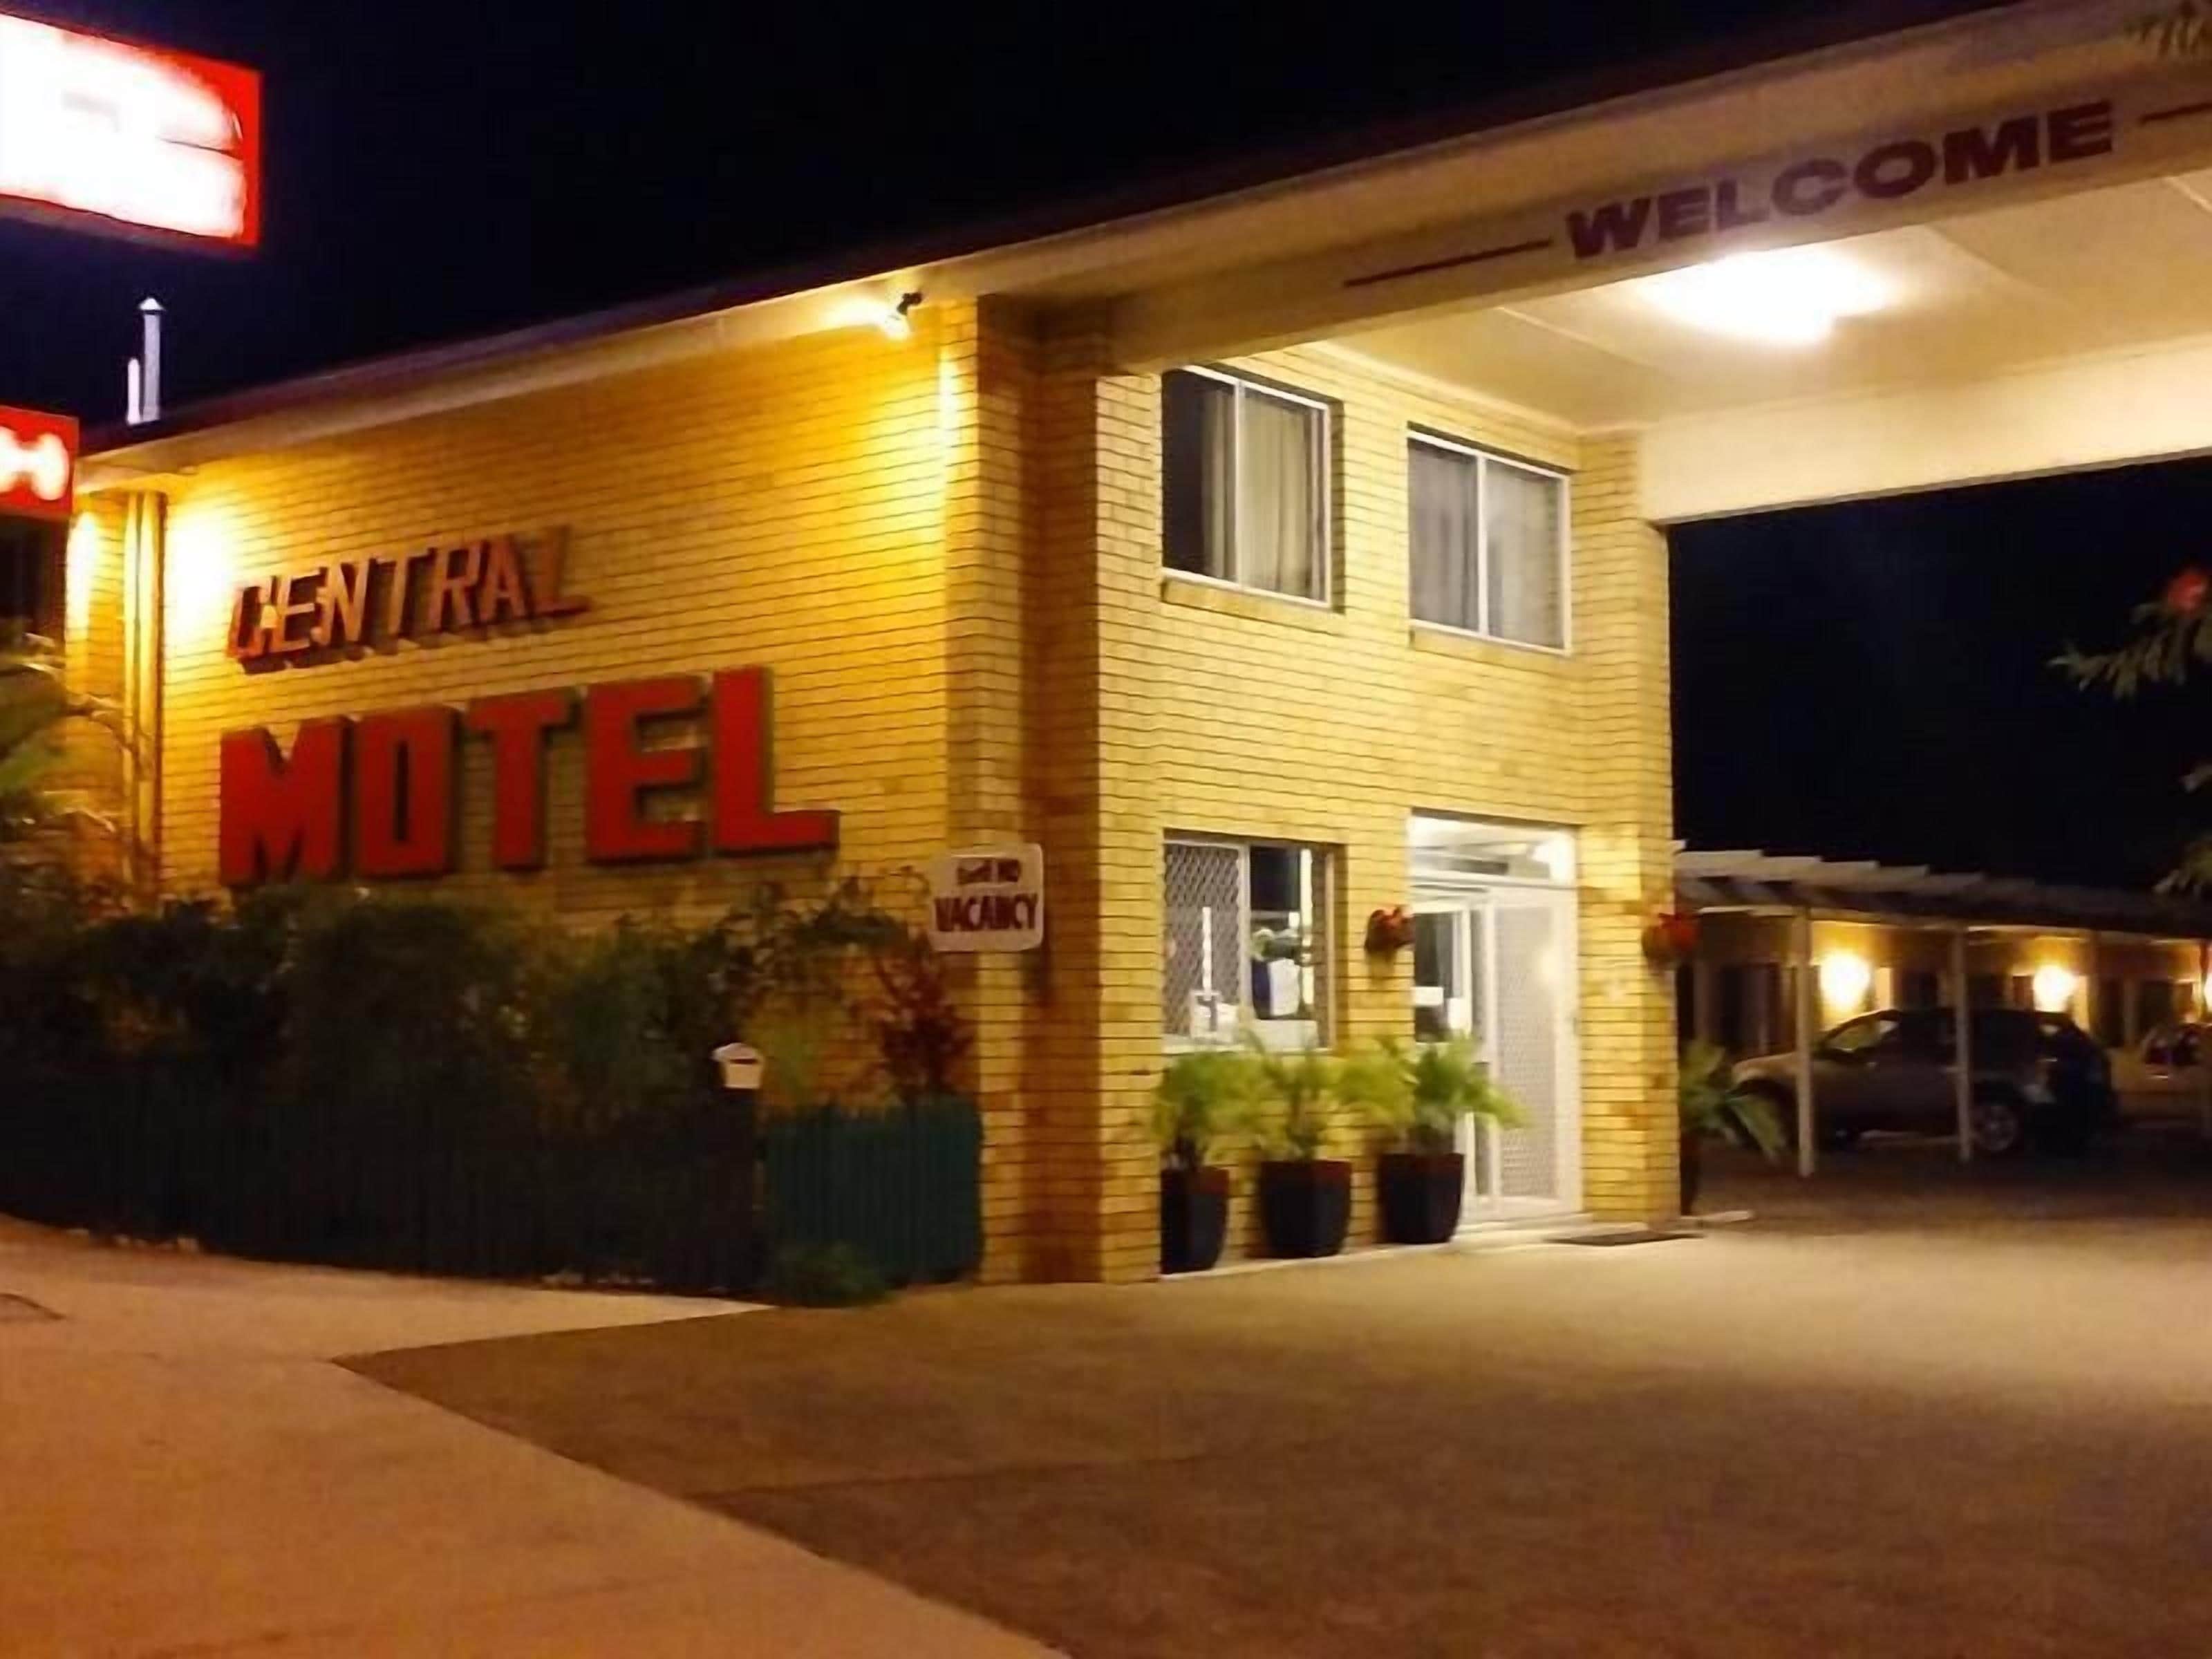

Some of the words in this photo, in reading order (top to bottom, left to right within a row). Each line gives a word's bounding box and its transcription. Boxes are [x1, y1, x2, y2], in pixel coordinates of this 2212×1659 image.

[1565, 100, 2114, 259] WELCOME
[227, 523, 592, 671] CENTRAL
[220, 665, 839, 887] MOTEL
